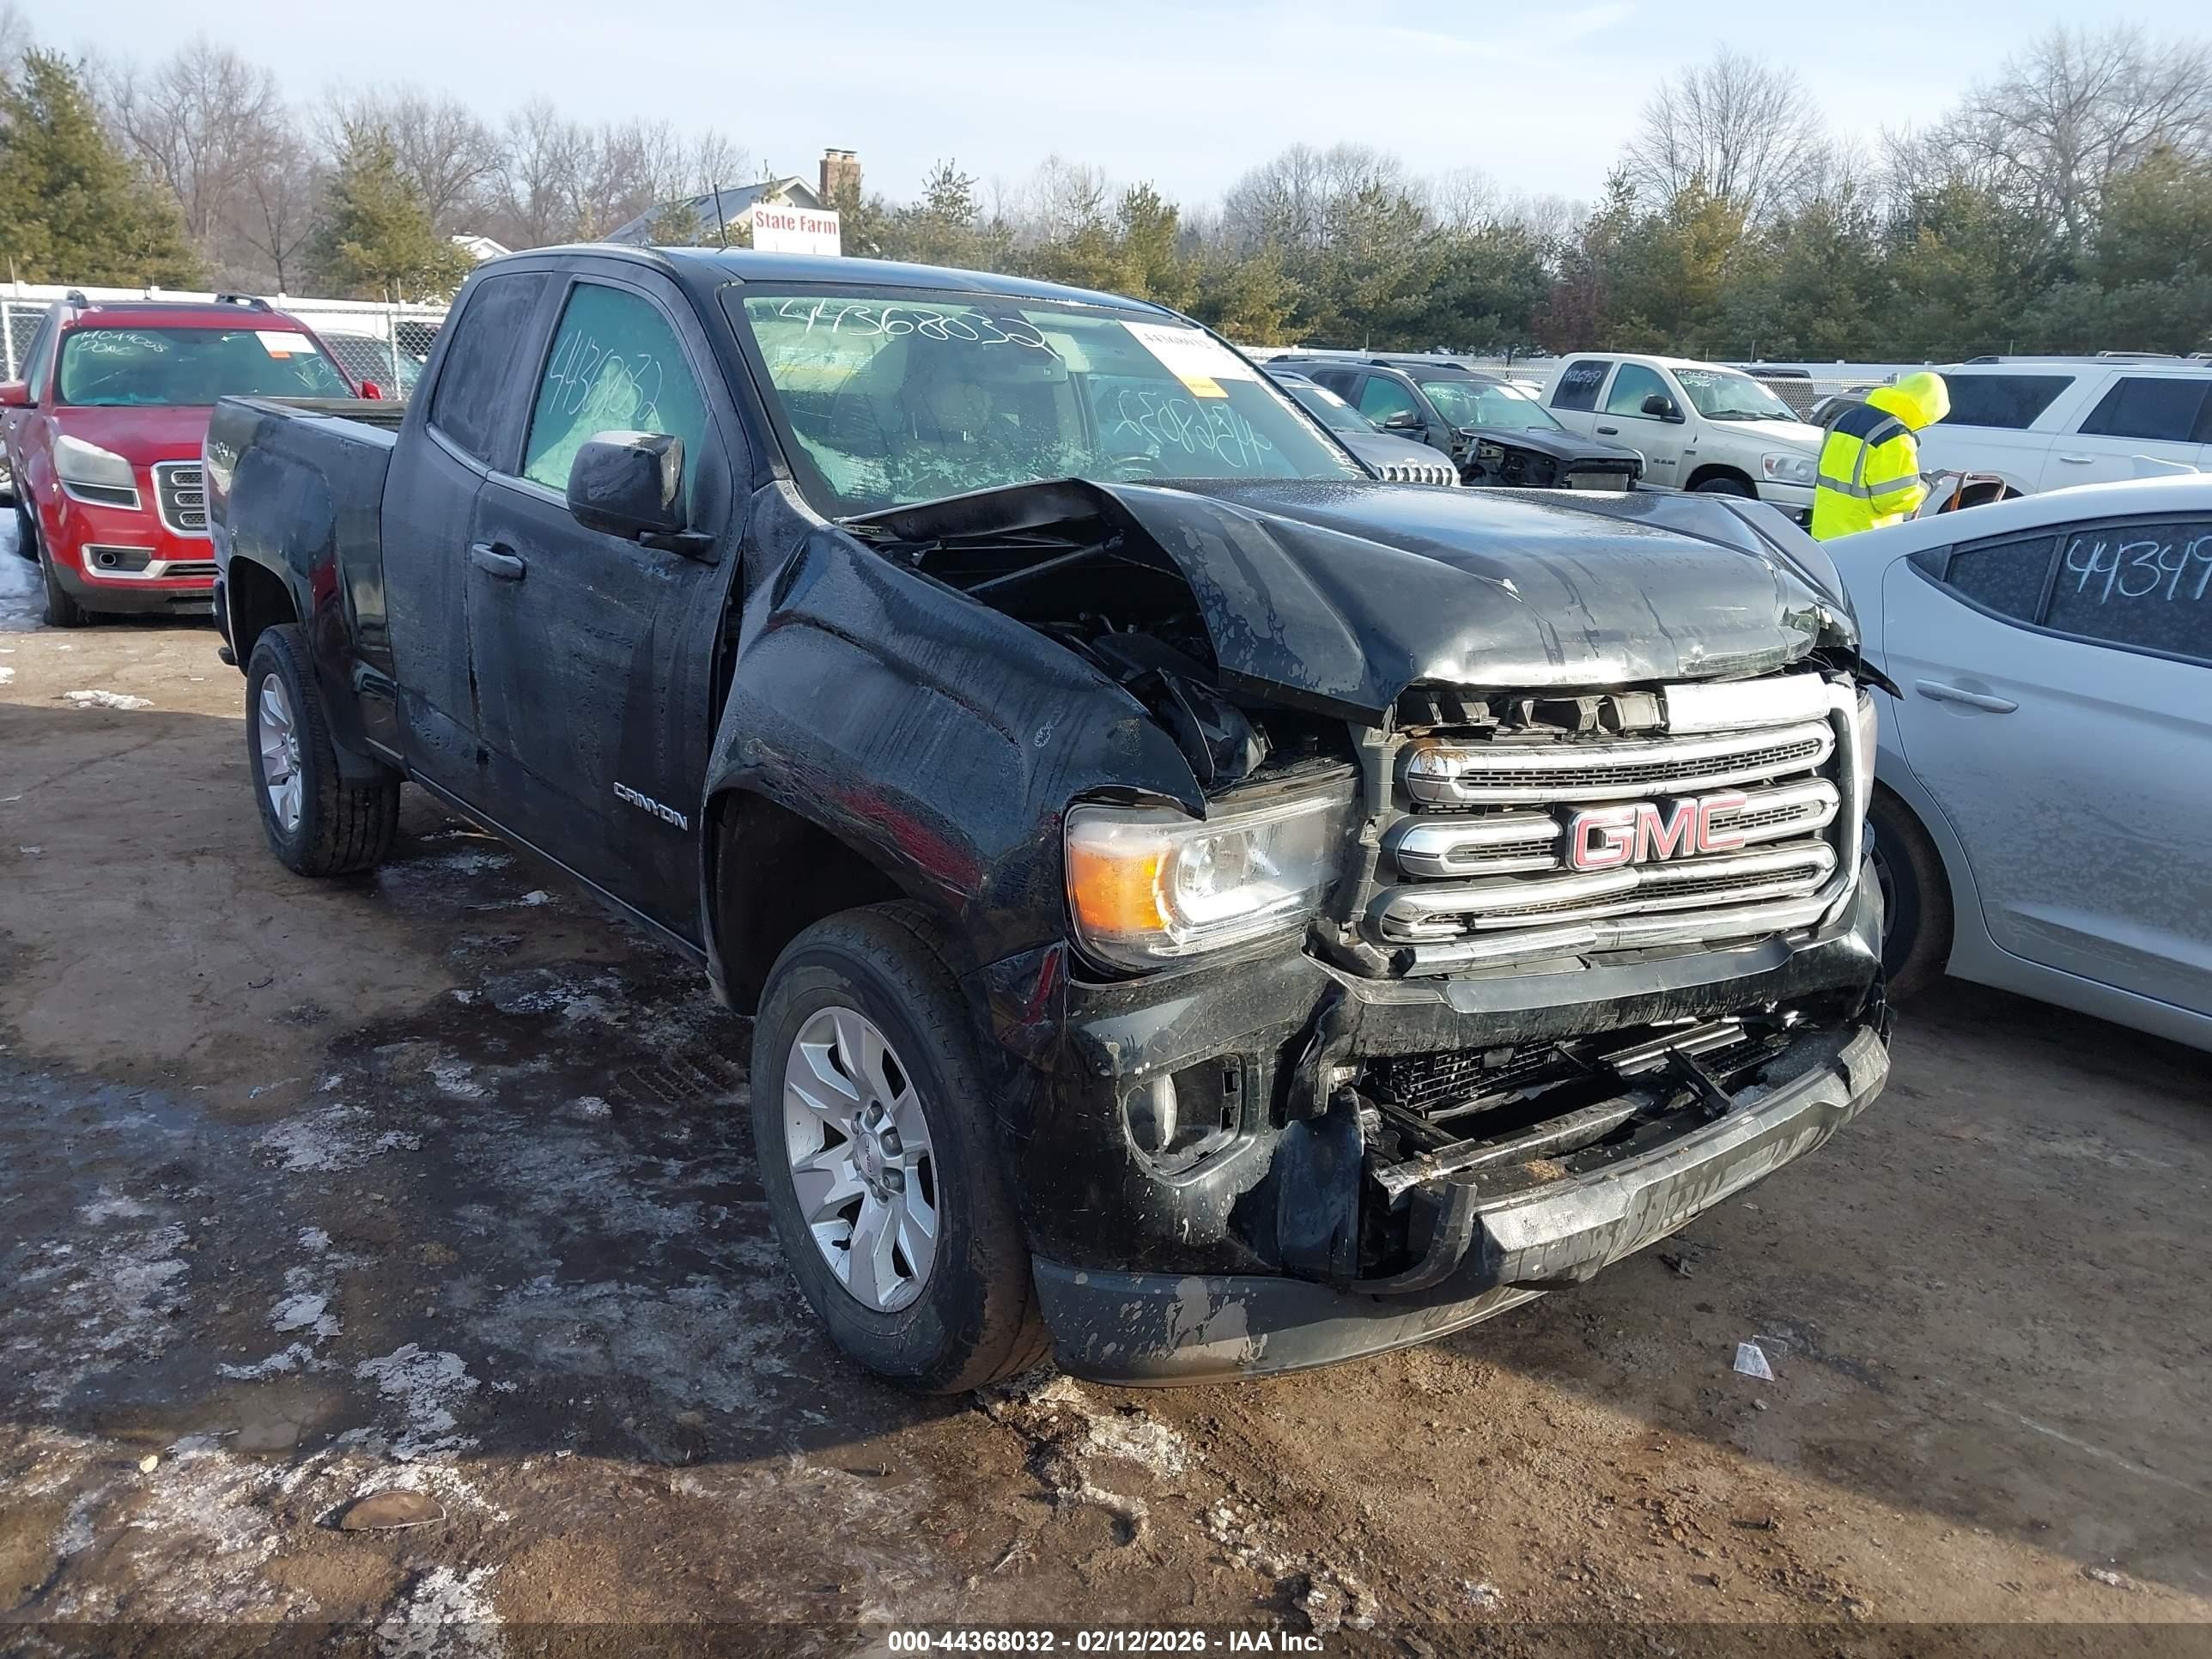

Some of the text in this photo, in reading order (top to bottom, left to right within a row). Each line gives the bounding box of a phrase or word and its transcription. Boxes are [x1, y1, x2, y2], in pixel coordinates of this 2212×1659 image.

[756, 211, 836, 234] State Farm
[779, 298, 1062, 362] 44368032
[549, 330, 663, 427] 44368032
[2067, 536, 2212, 605] 44349
[613, 781, 688, 831] CANYON
[1566, 787, 1747, 872] GMC
